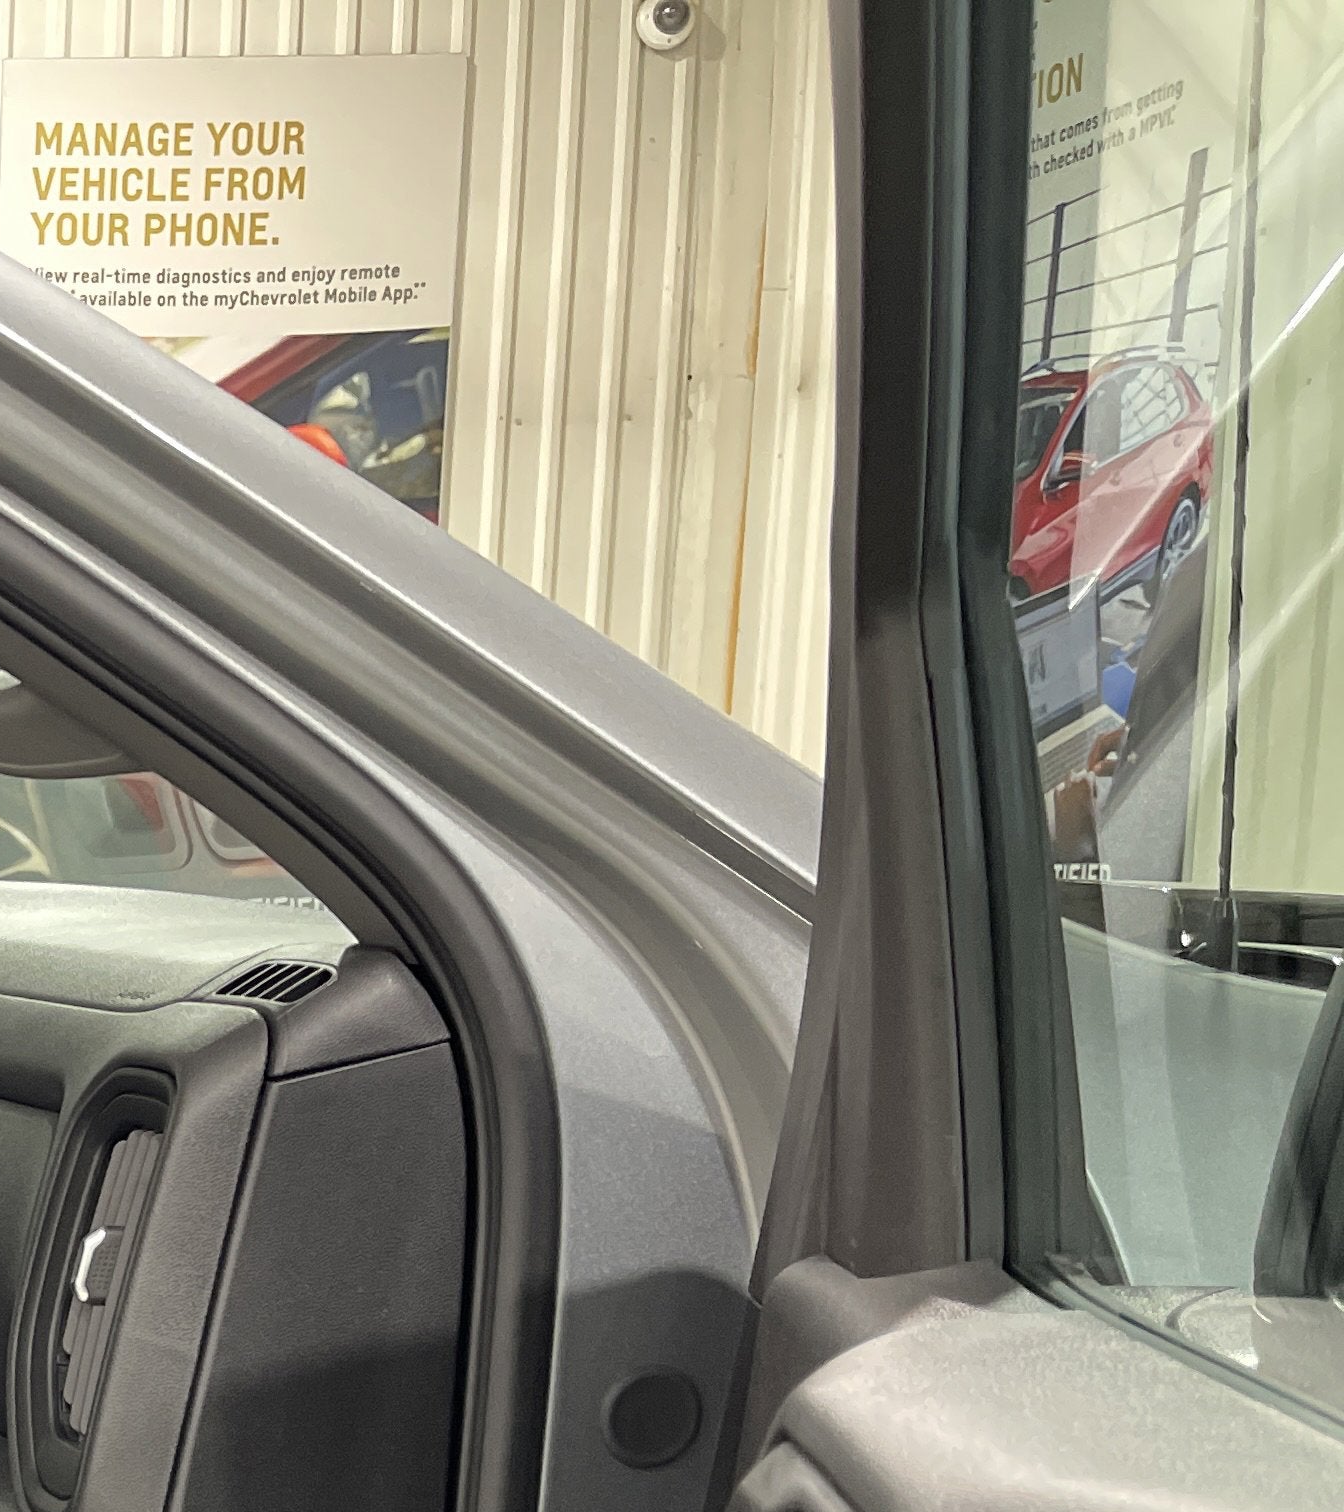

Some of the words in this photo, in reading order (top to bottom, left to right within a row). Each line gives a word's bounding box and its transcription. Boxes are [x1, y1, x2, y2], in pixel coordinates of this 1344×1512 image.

[1030, 130, 1055, 153] that
[1059, 115, 1099, 142] comes
[1101, 101, 1132, 126] from
[1136, 80, 1184, 117] getting
[35, 121, 196, 157] MANAGE
[206, 120, 305, 156] YOUR
[1043, 139, 1094, 174] checked
[1096, 128, 1124, 155] with
[1126, 127, 1137, 143] a
[32, 166, 192, 203] VEHICLE
[204, 165, 306, 202] FROM
[31, 211, 130, 247] YOUR
[144, 211, 280, 248] PHONE.
[72, 267, 151, 284] real-time
[156, 266, 251, 288] diagnostics
[256, 266, 286, 283] and
[291, 266, 335, 286] enjoy
[340, 263, 400, 281] remote
[79, 290, 151, 307] available
[157, 294, 176, 307] on
[182, 291, 209, 307] the
[213, 288, 319, 309] myChevrolet
[324, 286, 377, 304] Mobile
